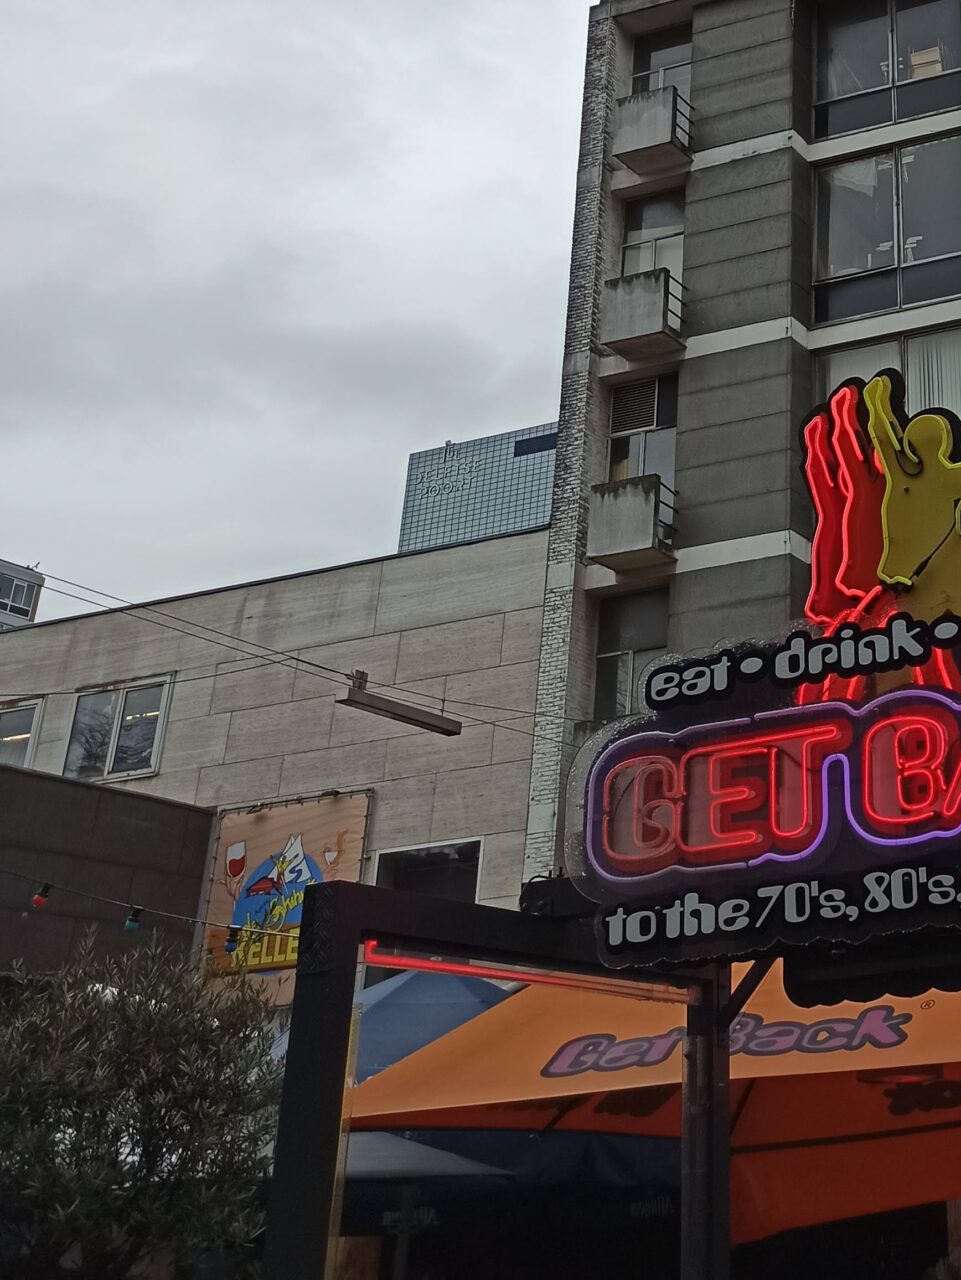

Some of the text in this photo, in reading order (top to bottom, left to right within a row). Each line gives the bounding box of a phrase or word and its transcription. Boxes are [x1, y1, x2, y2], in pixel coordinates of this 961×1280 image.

[414, 460, 481, 485] DELFTSE
[419, 477, 474, 500] POORT
[650, 658, 732, 702] eat
[774, 619, 925, 679] drink
[602, 724, 848, 862] GET
[605, 907, 657, 946] to
[662, 892, 750, 939] the
[543, 1027, 686, 1078] Get
